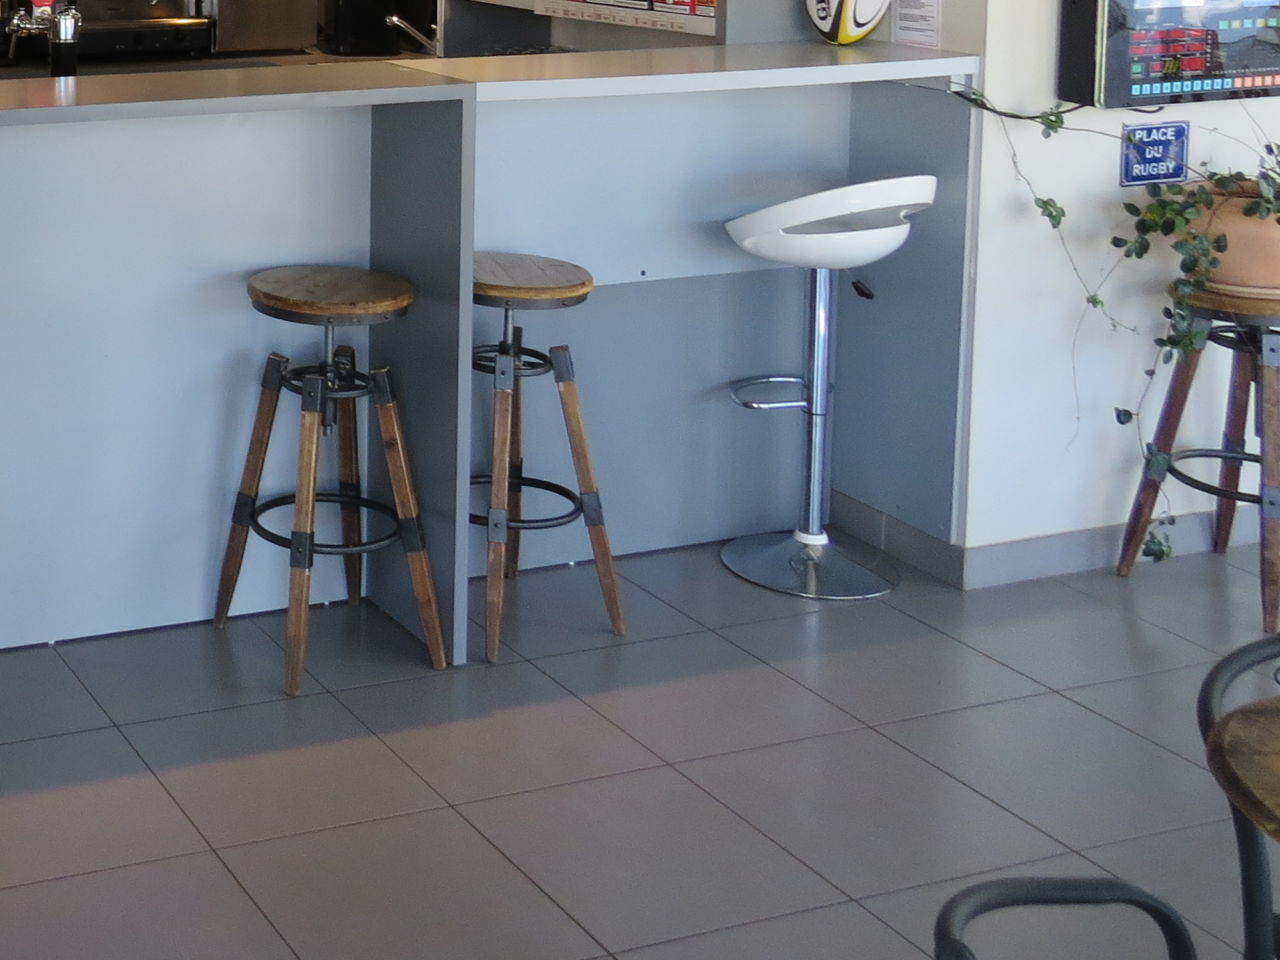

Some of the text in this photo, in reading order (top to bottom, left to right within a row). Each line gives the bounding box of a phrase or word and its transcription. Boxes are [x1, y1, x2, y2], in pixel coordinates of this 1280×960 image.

[1135, 128, 1175, 141] PLACE
[1145, 146, 1162, 159] DU
[1132, 160, 1176, 177] RUGBY
